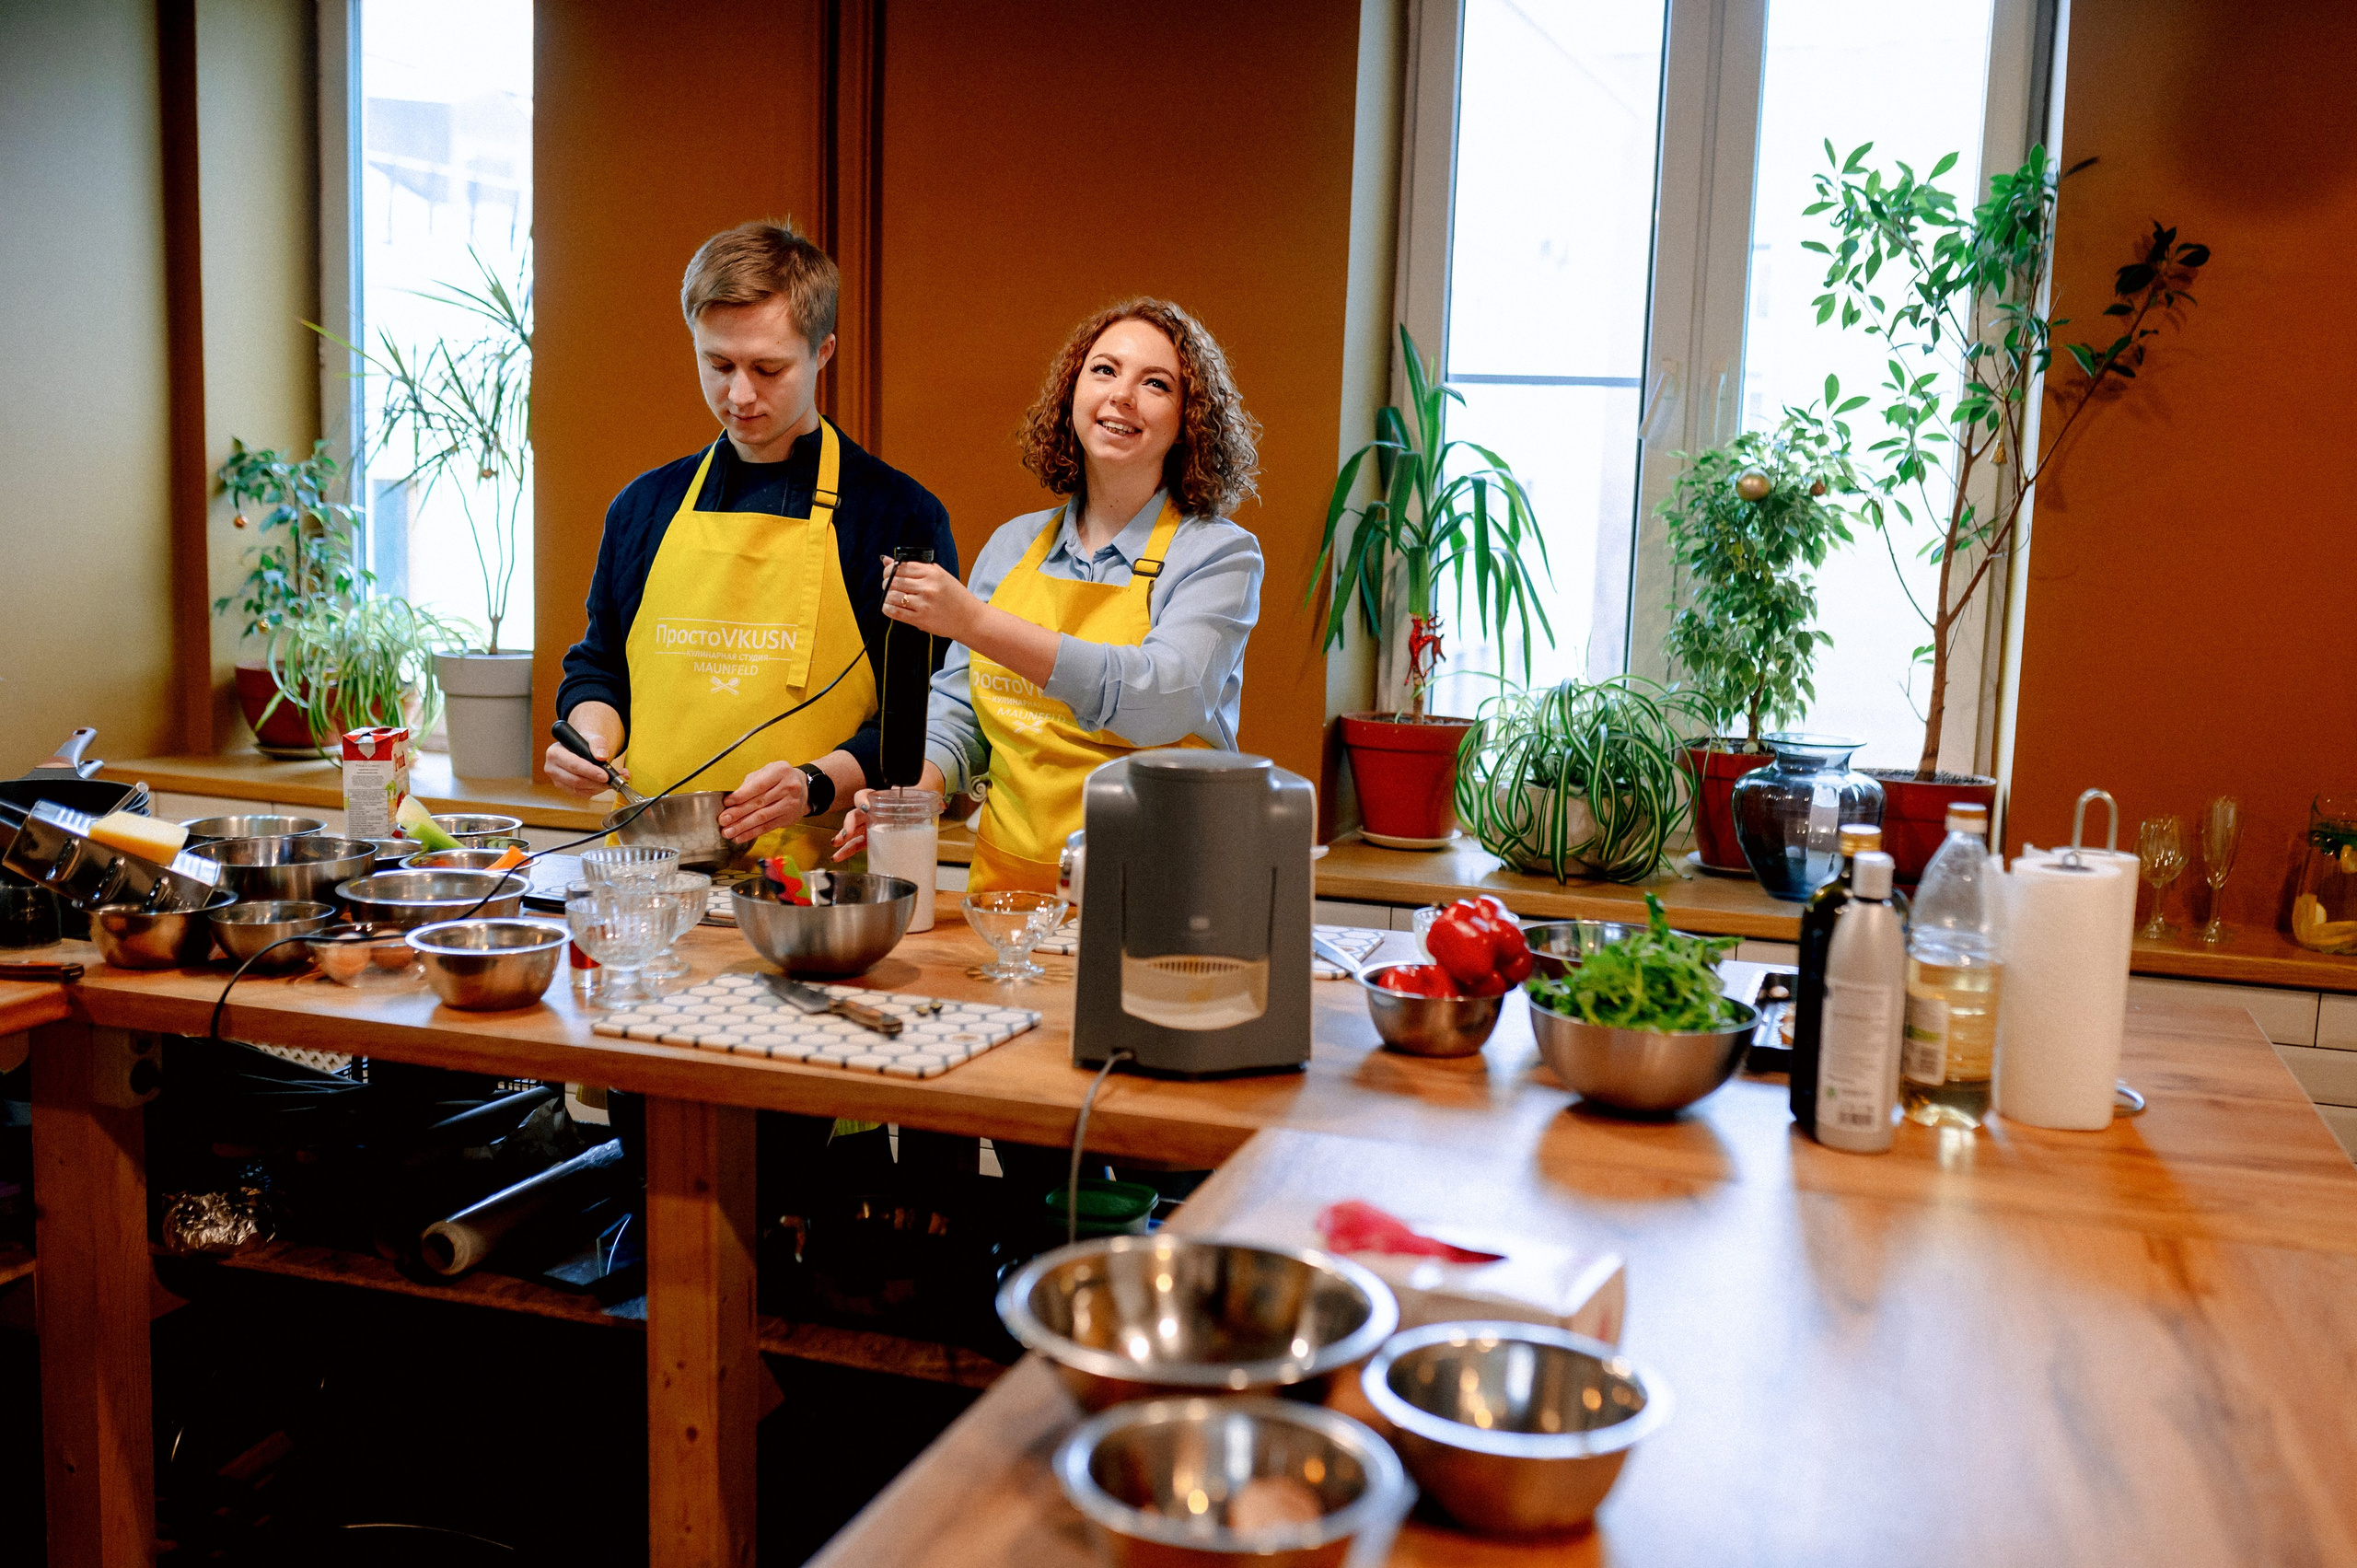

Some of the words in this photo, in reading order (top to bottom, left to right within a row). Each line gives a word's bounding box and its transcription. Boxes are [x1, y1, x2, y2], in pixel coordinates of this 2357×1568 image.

[656, 623, 797, 650] ПростоVKUSN
[686, 650, 737, 660] КУЛИНАРНАЯ
[738, 654, 769, 662] СТУДИЯ
[693, 662, 759, 676] MAUNFELD
